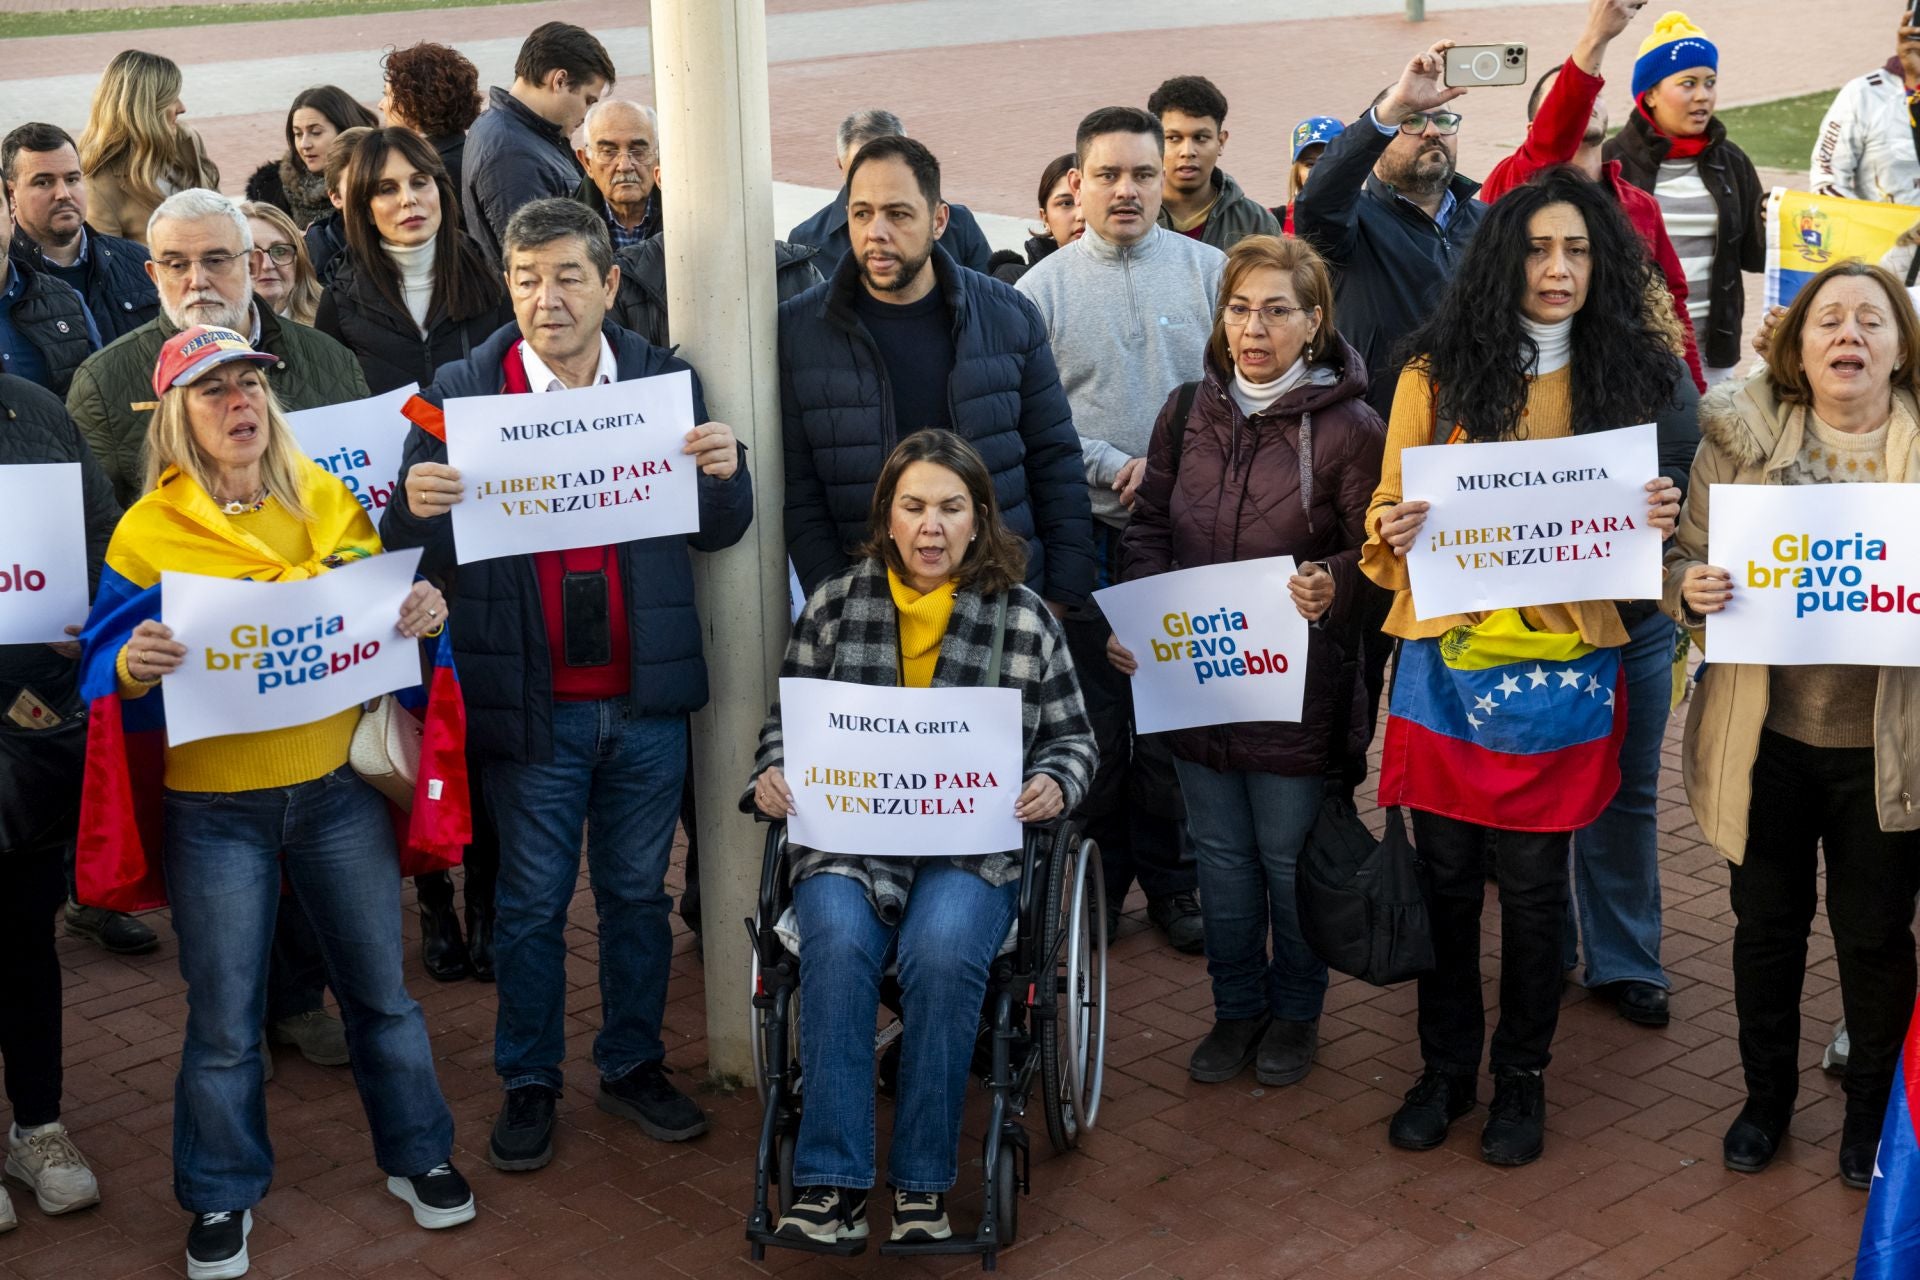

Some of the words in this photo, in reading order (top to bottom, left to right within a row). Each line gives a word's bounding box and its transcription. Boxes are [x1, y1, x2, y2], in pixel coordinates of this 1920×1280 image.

[500, 418, 588, 442] MURCIA
[592, 413, 645, 431] GRITA
[477, 469, 605, 500] ¡LIBERTAD
[612, 459, 672, 481] PARA
[1456, 471, 1547, 491] MURCIA
[1552, 467, 1609, 484] GRITA
[501, 485, 650, 517] VENEZUELA!
[1431, 522, 1563, 552] ¡LIBERTAD
[1570, 515, 1636, 536] PARA
[1772, 532, 1887, 562] Gloria
[1455, 541, 1611, 570] VENEZUELA!
[1747, 560, 1862, 588] bravo
[230, 614, 344, 648] Gloria
[1162, 607, 1248, 637] Gloria
[205, 645, 323, 671] bravo
[1151, 636, 1236, 662] bravo
[258, 641, 380, 694] pueblo
[1193, 649, 1288, 684] pueblo
[828, 712, 910, 734] MURCIA
[915, 720, 970, 734] GRITA
[804, 766, 927, 790] ¡LIBERTAD
[934, 772, 998, 789] PARA
[825, 794, 975, 815] VENEZUELA!
